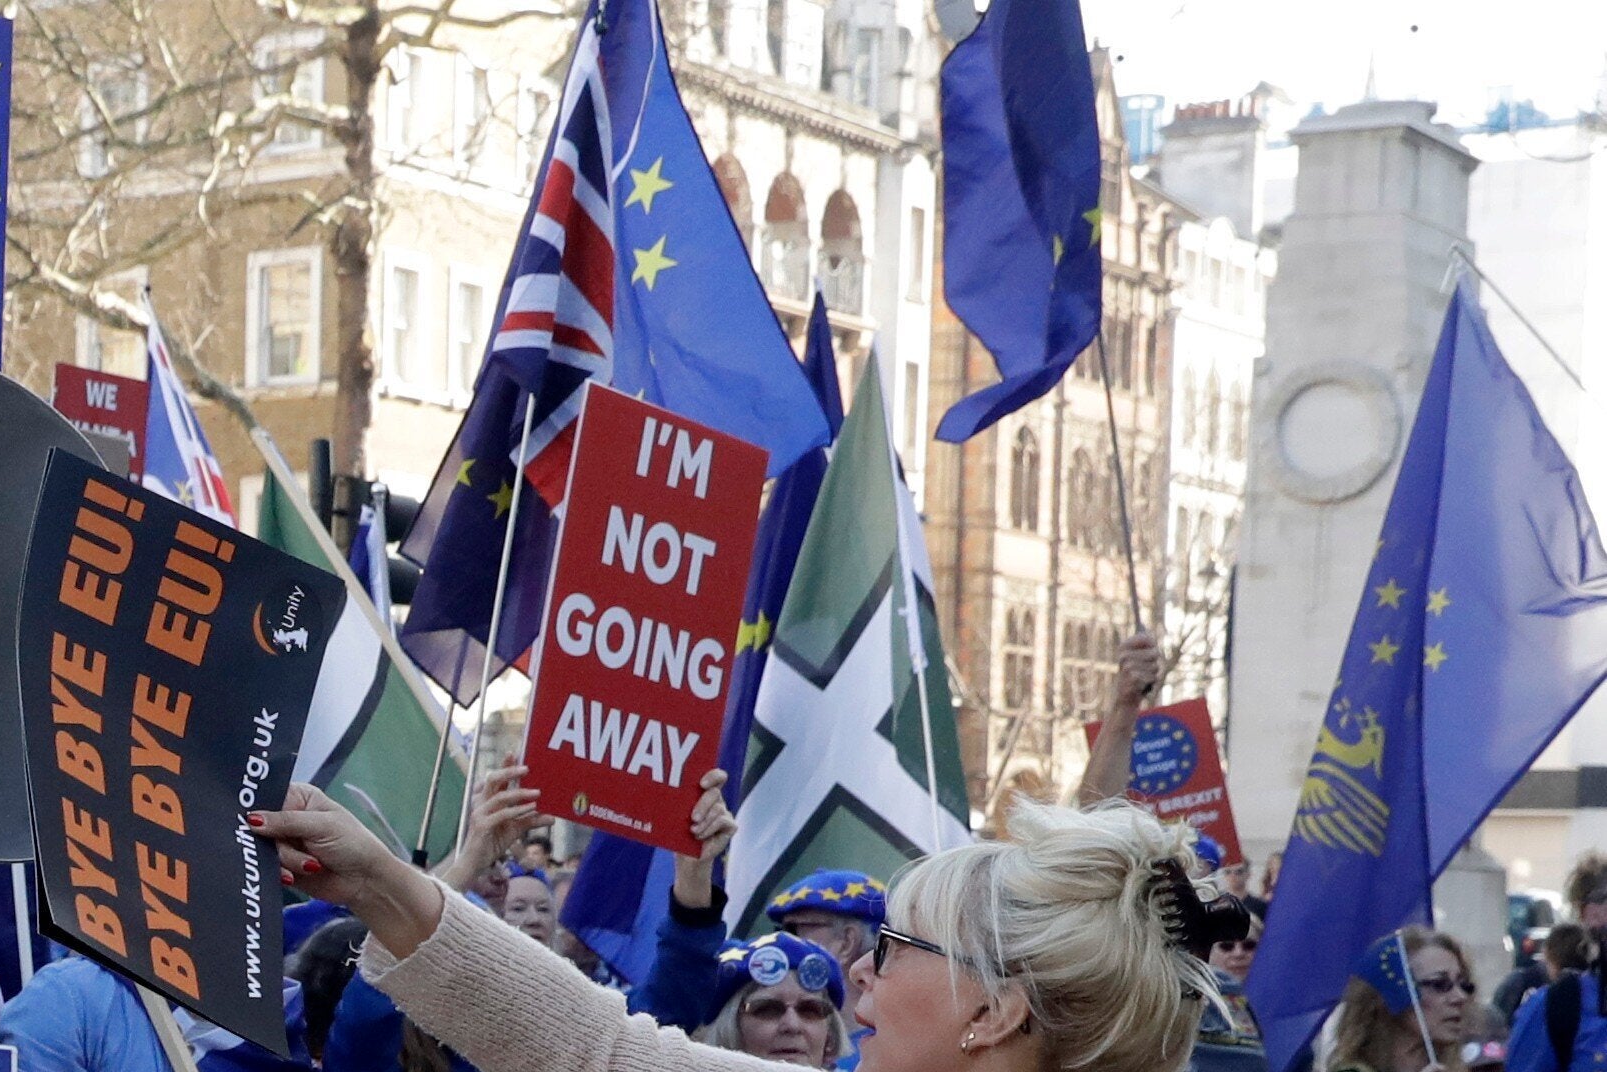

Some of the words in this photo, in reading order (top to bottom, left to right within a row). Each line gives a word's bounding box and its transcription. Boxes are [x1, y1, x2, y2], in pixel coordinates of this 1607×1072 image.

[85, 379, 118, 411] WE
[635, 416, 715, 500] I'M
[59, 477, 146, 627] EU!
[145, 519, 237, 667] EU!
[281, 585, 306, 629] Unity
[600, 505, 717, 596] NOT
[555, 592, 727, 701] GOING
[50, 631, 107, 796] BYE
[130, 673, 193, 836] BYE
[547, 693, 700, 789] AWAY
[61, 797, 128, 958] BYE
[135, 841, 201, 1000] BYE
